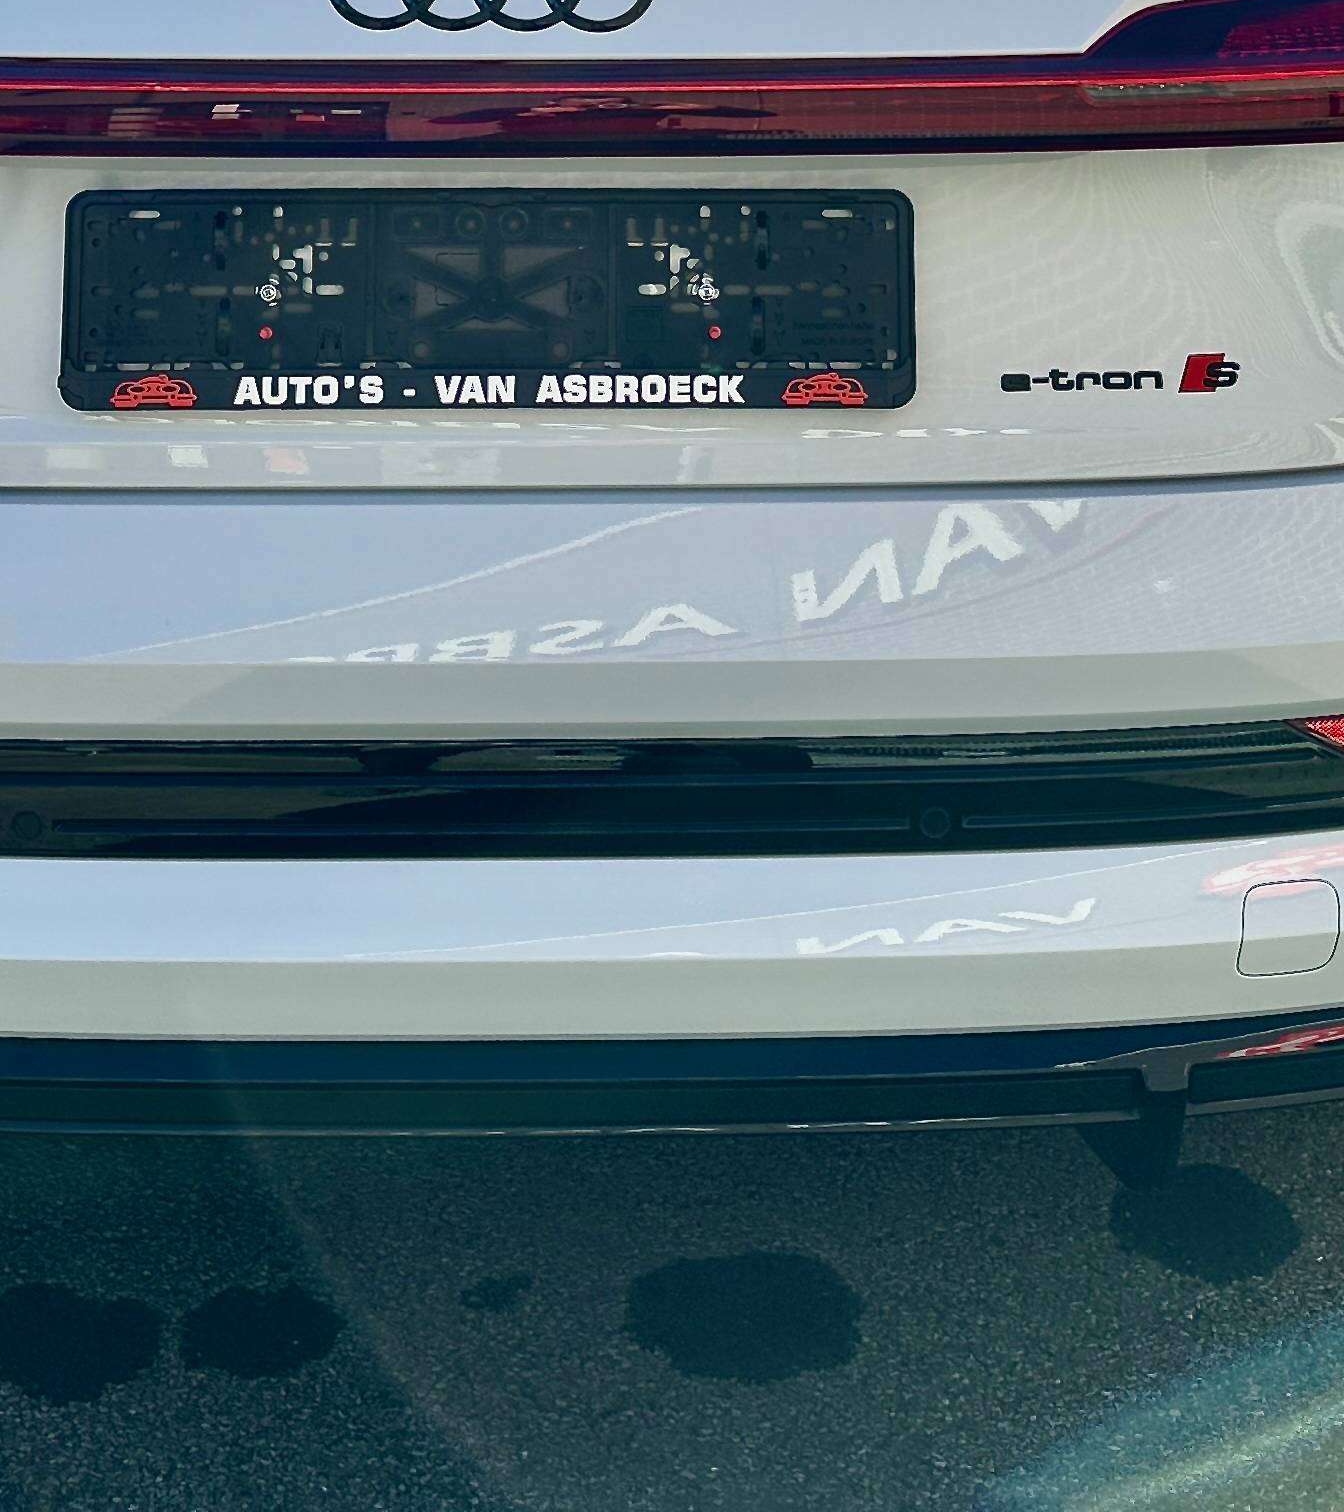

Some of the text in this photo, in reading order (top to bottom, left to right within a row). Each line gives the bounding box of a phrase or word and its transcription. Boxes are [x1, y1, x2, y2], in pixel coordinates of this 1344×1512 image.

[233, 375, 384, 405] AUTO'S
[434, 375, 516, 404] VAN
[535, 374, 746, 404] ASBROECK
[1000, 369, 1164, 392] e-tron
